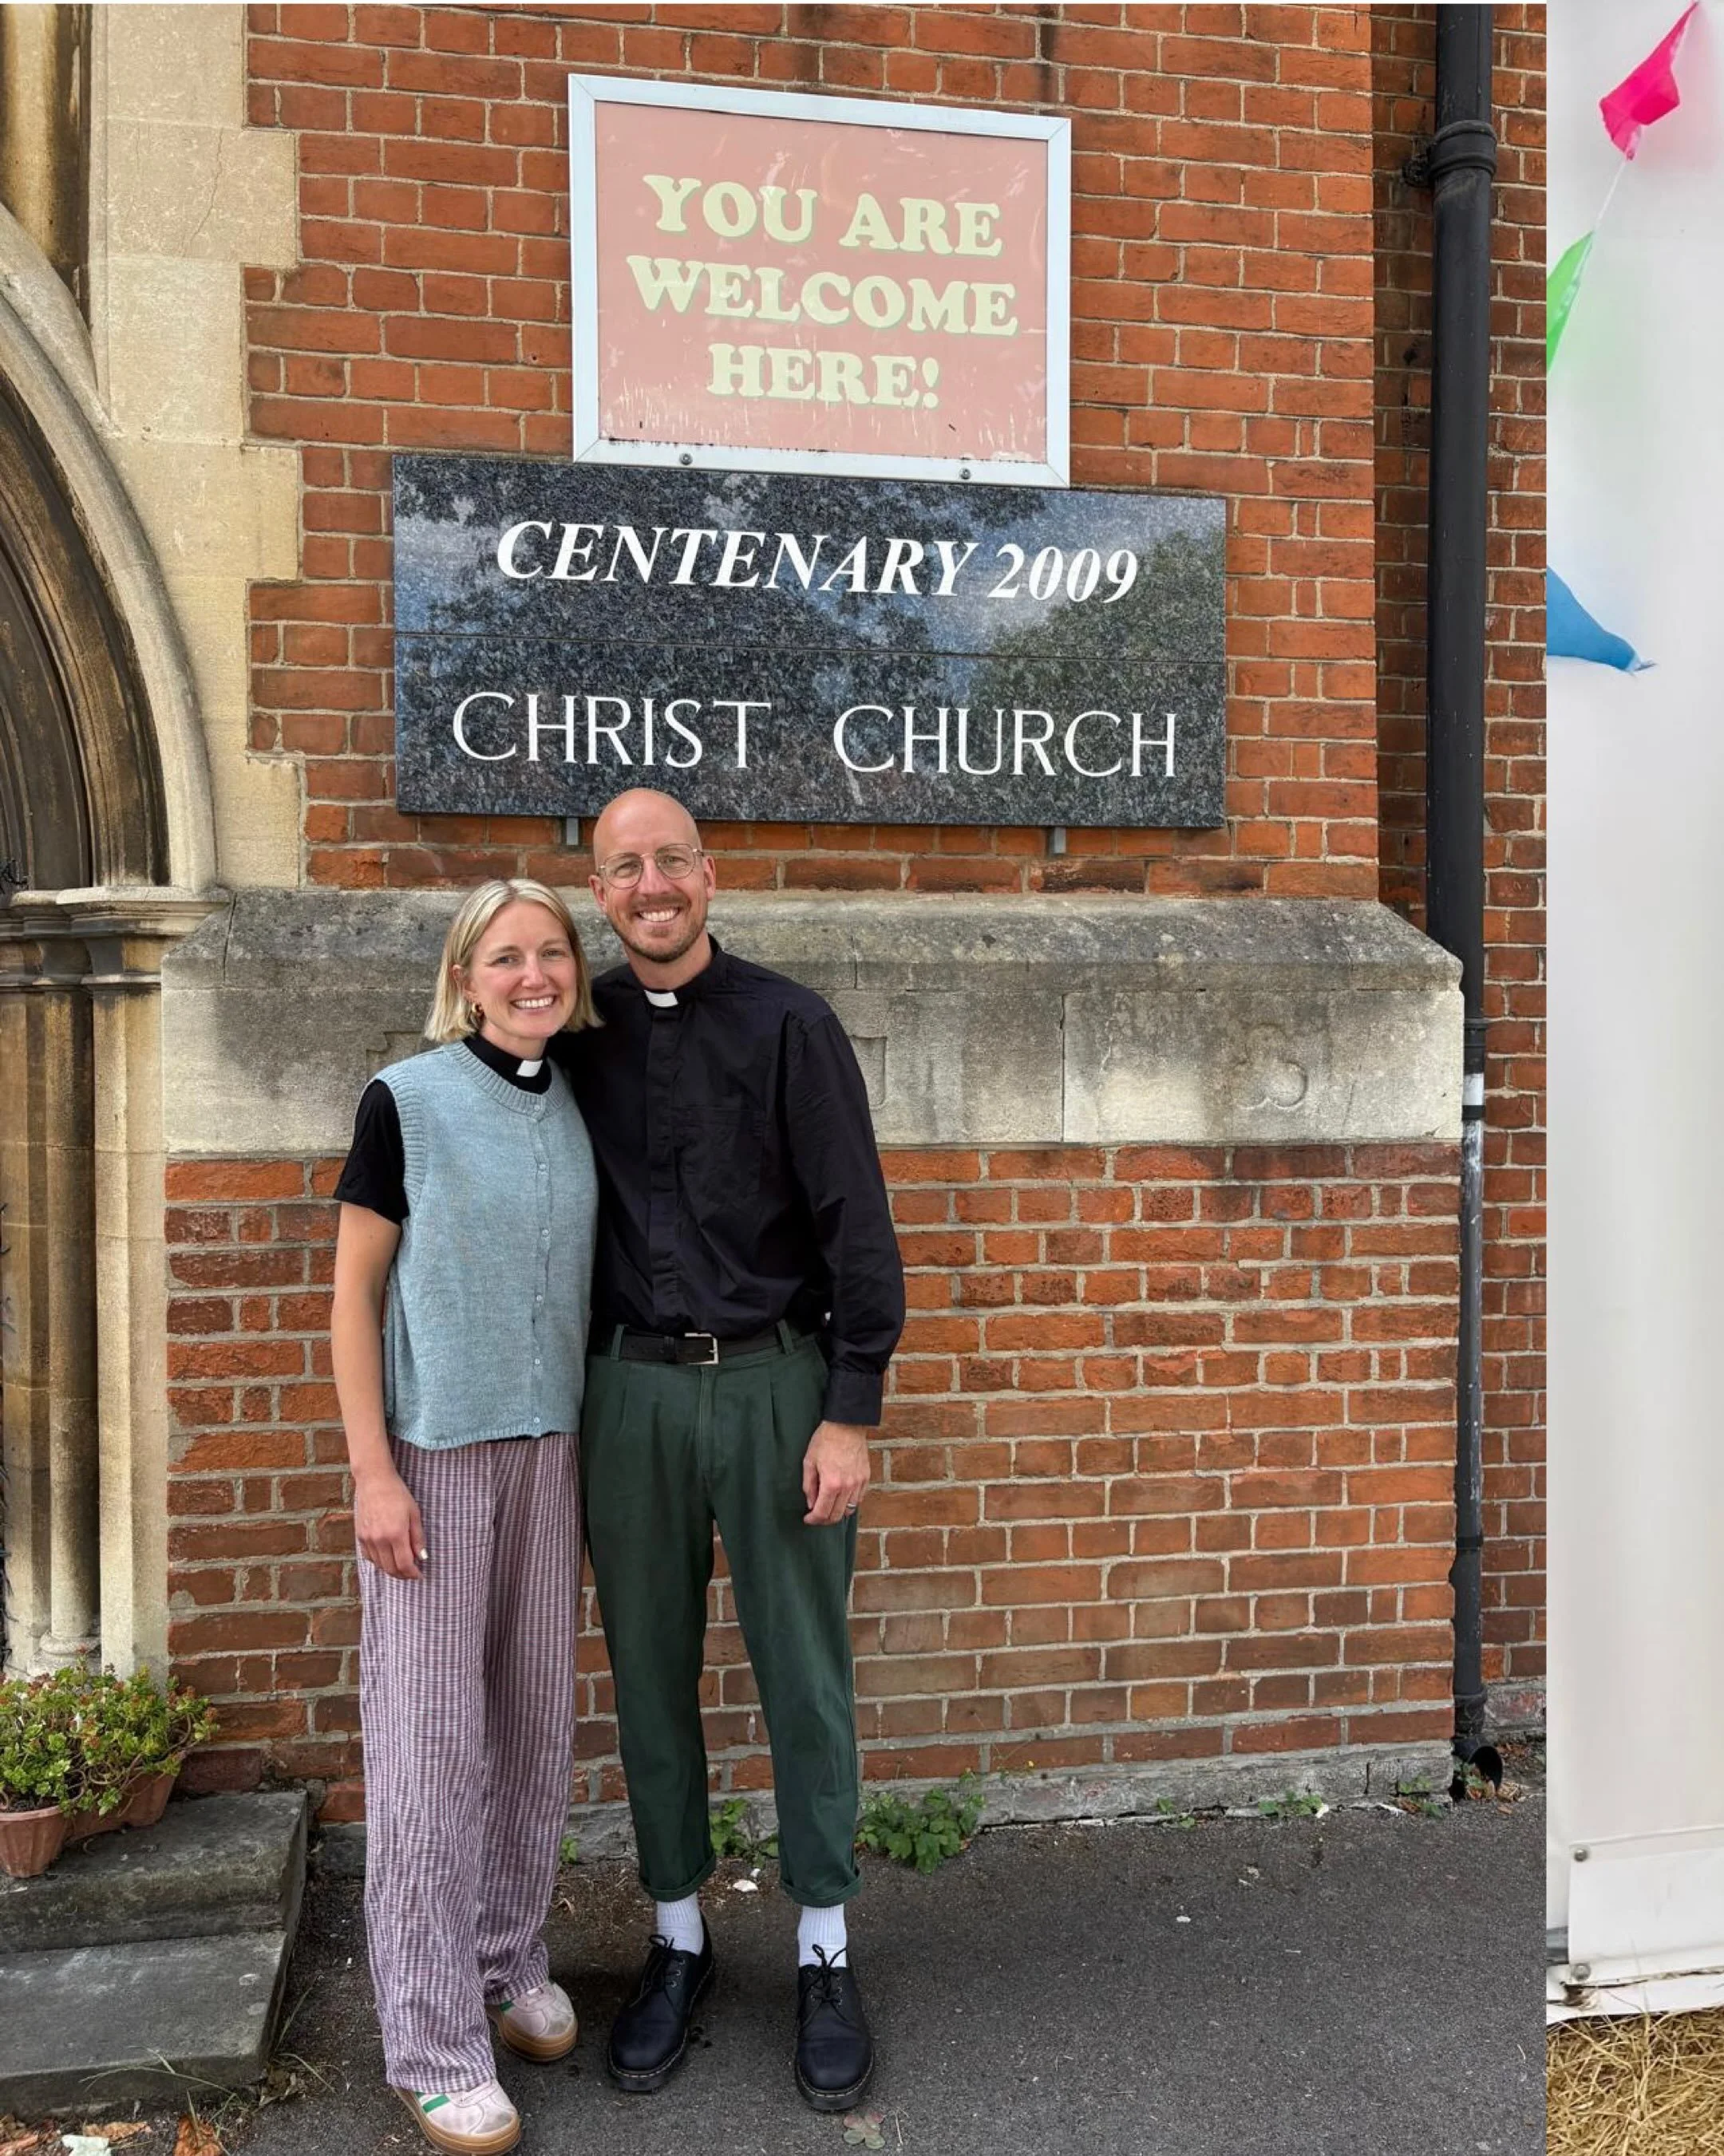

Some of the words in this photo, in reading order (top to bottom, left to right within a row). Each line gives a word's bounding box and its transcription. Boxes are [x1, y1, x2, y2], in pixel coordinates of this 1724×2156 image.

[643, 175, 818, 243] YOU
[838, 192, 1004, 258] ARE
[626, 255, 1019, 337] WELCOME
[706, 343, 941, 410] HERE!
[496, 519, 979, 597] CENTENARY
[987, 543, 1138, 604] 2009
[452, 692, 772, 769] CHRIST
[832, 705, 1176, 778] CHURCH
